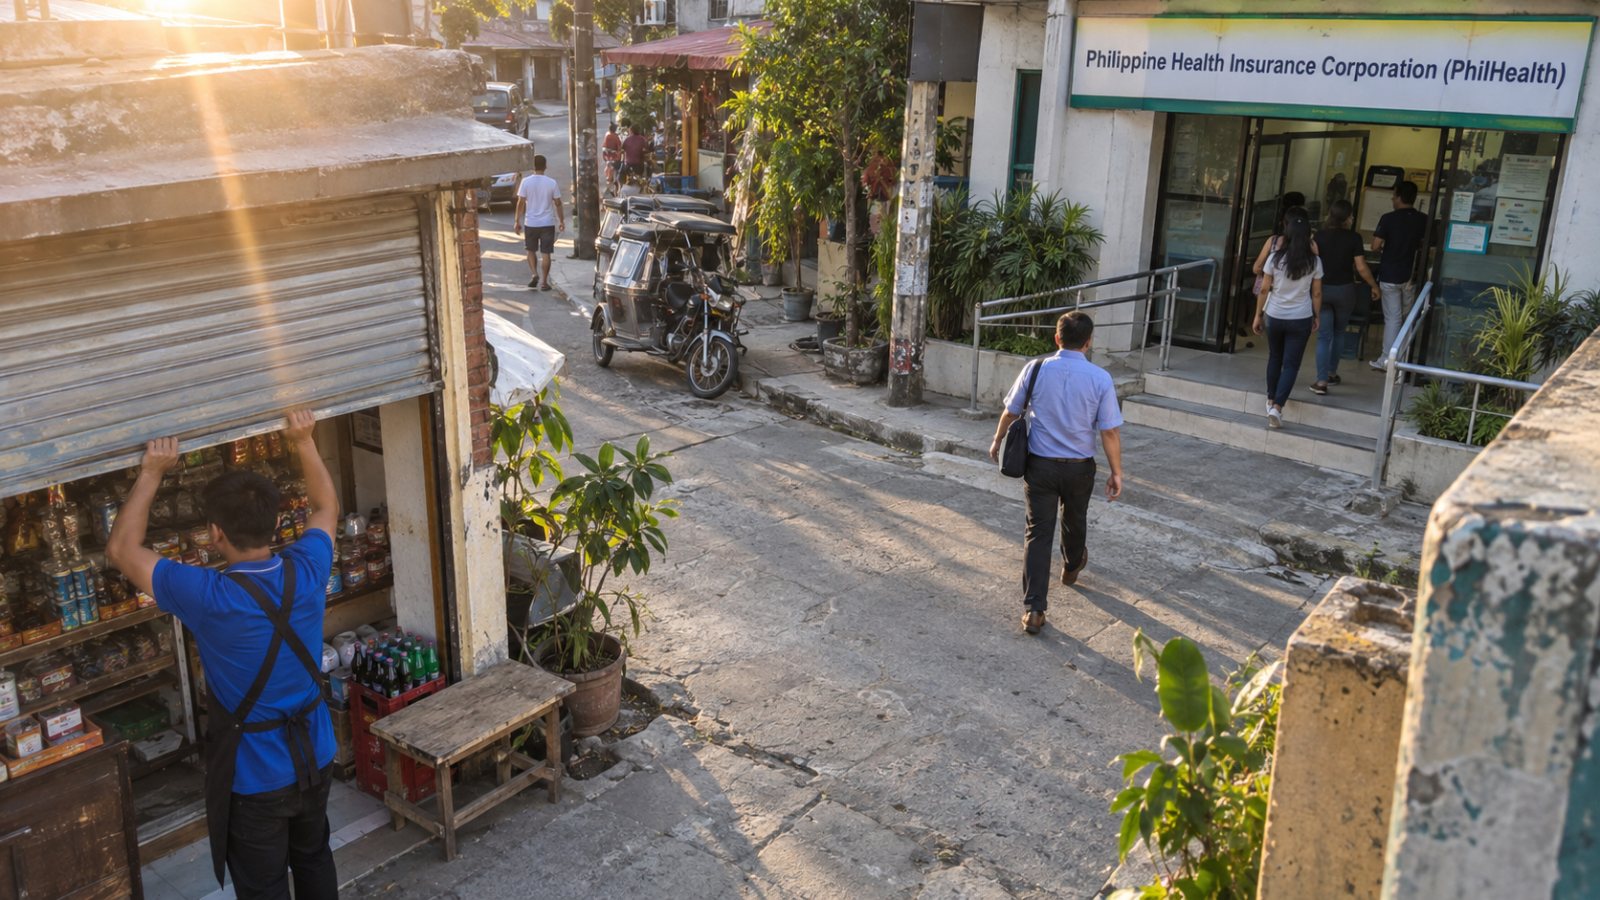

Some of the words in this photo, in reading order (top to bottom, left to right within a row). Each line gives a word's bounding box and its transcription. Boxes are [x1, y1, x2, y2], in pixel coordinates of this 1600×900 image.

[1086, 50, 1167, 74] Philippine
[1171, 52, 1225, 72] Health
[1229, 53, 1317, 76] Insurance
[1321, 55, 1438, 83] Corporation
[1443, 58, 1567, 91] (PhilHealth)
